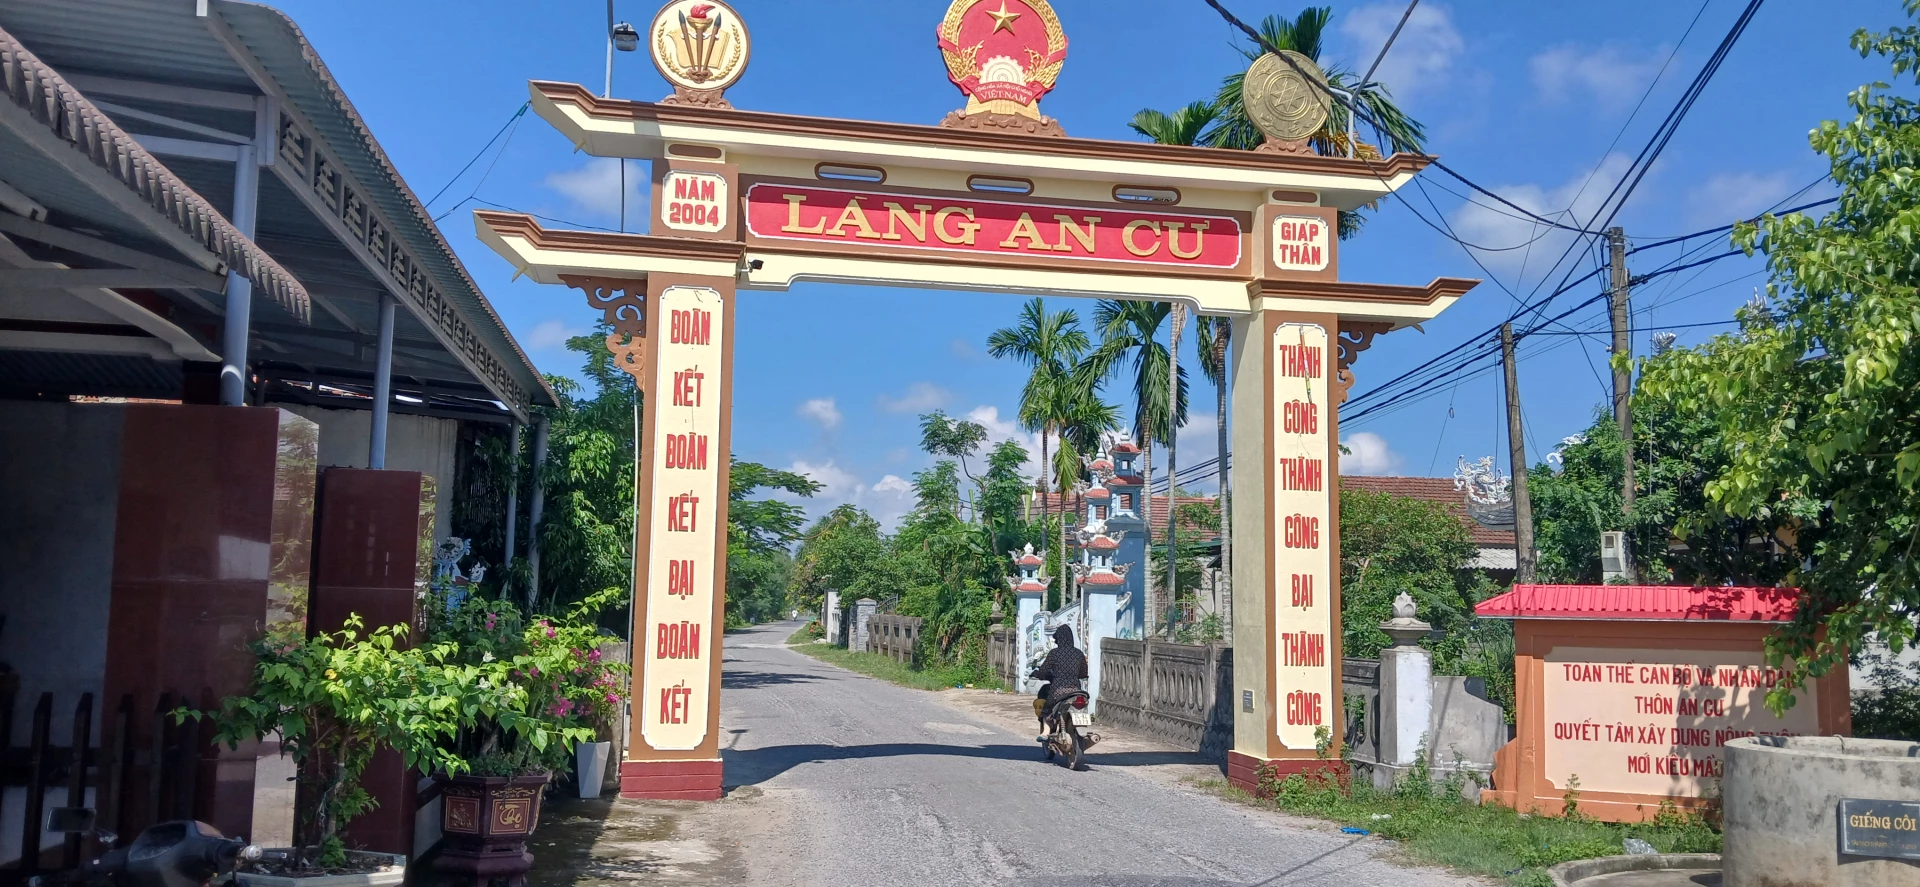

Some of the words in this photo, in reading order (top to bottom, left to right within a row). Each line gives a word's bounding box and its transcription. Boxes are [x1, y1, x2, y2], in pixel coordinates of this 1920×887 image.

[980, 89, 1004, 99] VIỆT
[1004, 91, 1027, 103] NAM
[675, 176, 715, 201] NĂM
[669, 202, 719, 226] 2004
[781, 194, 981, 245] LÀNG
[999, 212, 1102, 253] AN
[1121, 219, 1210, 260] CƯ
[1281, 220, 1318, 242] GIÁP
[1279, 242, 1320, 265] THÂN
[670, 308, 710, 345] ĐOÀN
[673, 364, 704, 407] KẾT
[1283, 399, 1317, 434] CÔNG
[665, 431, 708, 470] ĐOÀN
[667, 489, 699, 532] KẾT
[1284, 513, 1318, 549] CÔNG
[668, 560, 694, 600] ĐẠI
[1291, 574, 1313, 611] ĐẠI
[657, 620, 700, 659] ĐOÀN
[1563, 661, 1602, 682] TOÀN
[1606, 659, 1634, 684] THỂ
[1640, 662, 1669, 685] CÁN
[1673, 663, 1692, 688] BỘ
[1696, 665, 1715, 687] VÀ
[1719, 666, 1761, 688] NHÂN
[660, 679, 692, 724] KẾT
[1286, 689, 1321, 725] CÔNG
[1634, 693, 1673, 715] THÔN
[1678, 698, 1698, 716] AN
[1703, 699, 1725, 717] CƯ
[1554, 717, 1601, 741] QUYẾT
[1605, 721, 1634, 743] TÂM
[1637, 723, 1666, 745] XÂY
[1627, 752, 1650, 774] MỚI
[1850, 810, 1891, 829] GIẾNG
[1894, 814, 1916, 831] CÔI
